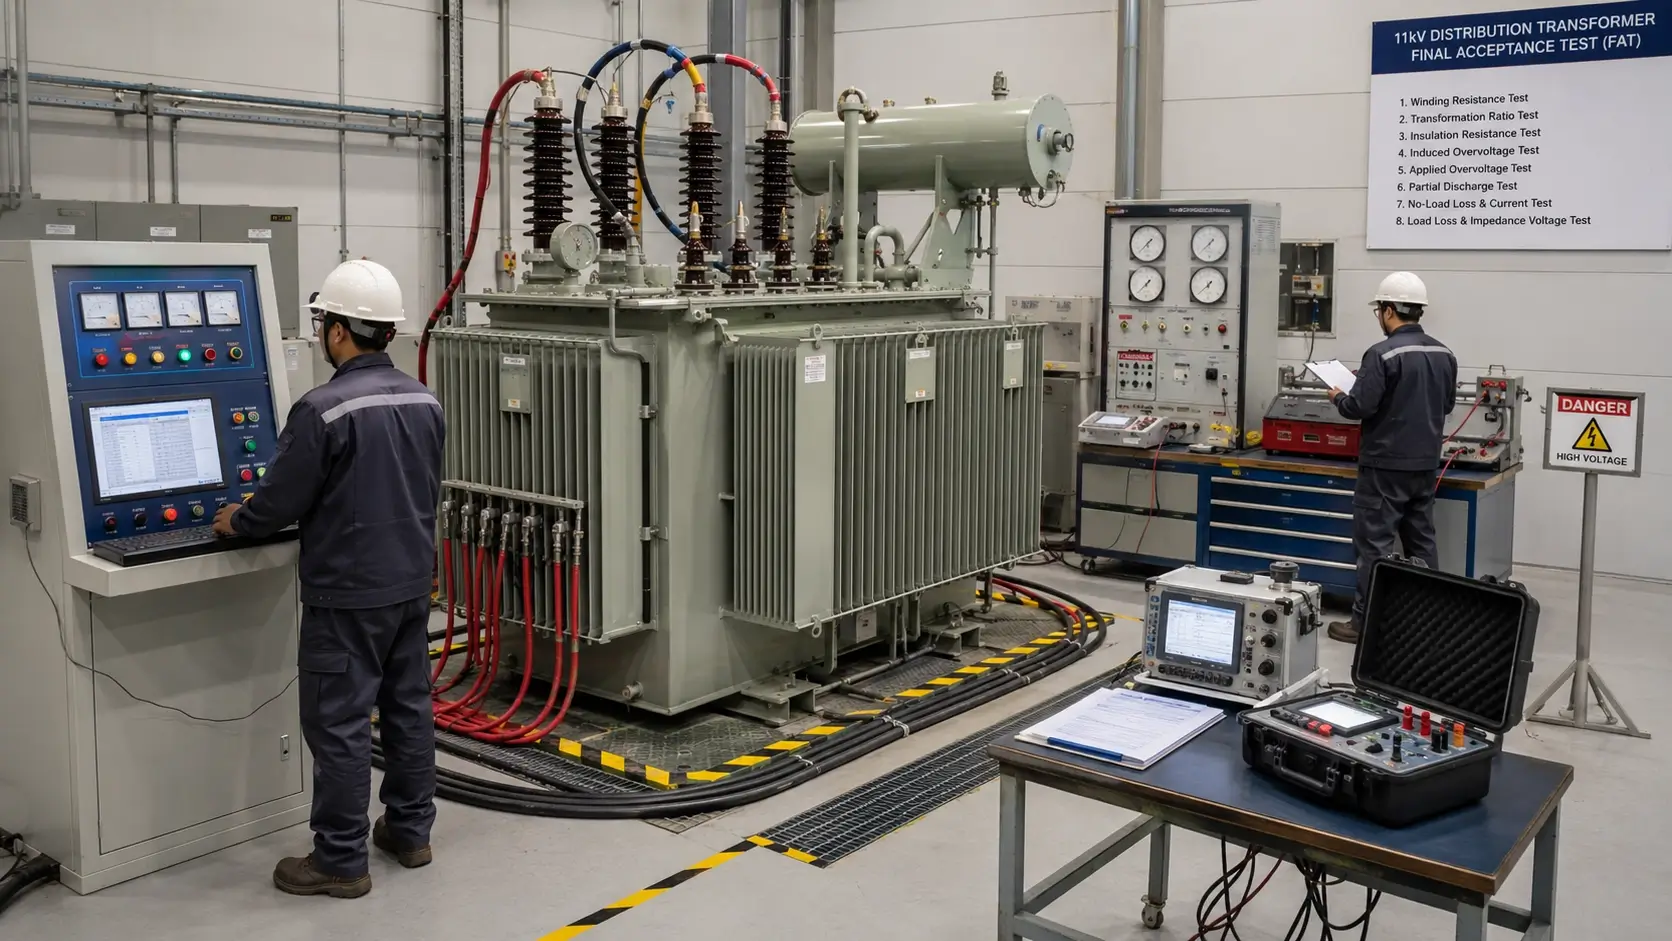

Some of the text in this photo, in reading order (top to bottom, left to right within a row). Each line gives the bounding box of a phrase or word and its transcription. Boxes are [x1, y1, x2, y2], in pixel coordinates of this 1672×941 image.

[1394, 12, 1656, 44] 11kV DISTRIBUTION TRANSFORMER
[1411, 33, 1642, 61] FINAL ACCEPTANCE TEST (FAT)
[1400, 94, 1528, 107] 1. Winding Resistance Test
[1399, 111, 1539, 124] 2. Transformation Ratio Test
[1399, 128, 1541, 141] 3. Insulation Resistance Test
[1398, 146, 1539, 157] 4. Induced Overvoltage Test
[1398, 163, 1532, 176] 5. Applied Overvoltage Test
[1397, 181, 1517, 193] 6. Partial Discharge Test
[1397, 198, 1552, 209] 7. No-Load Loss & Current Test
[1396, 215, 1591, 227] 8. Load Loss & Impedance Voltage Test
[1562, 399, 1627, 414] DANGER
[1557, 453, 1627, 465] HIGH VOLTAGE
